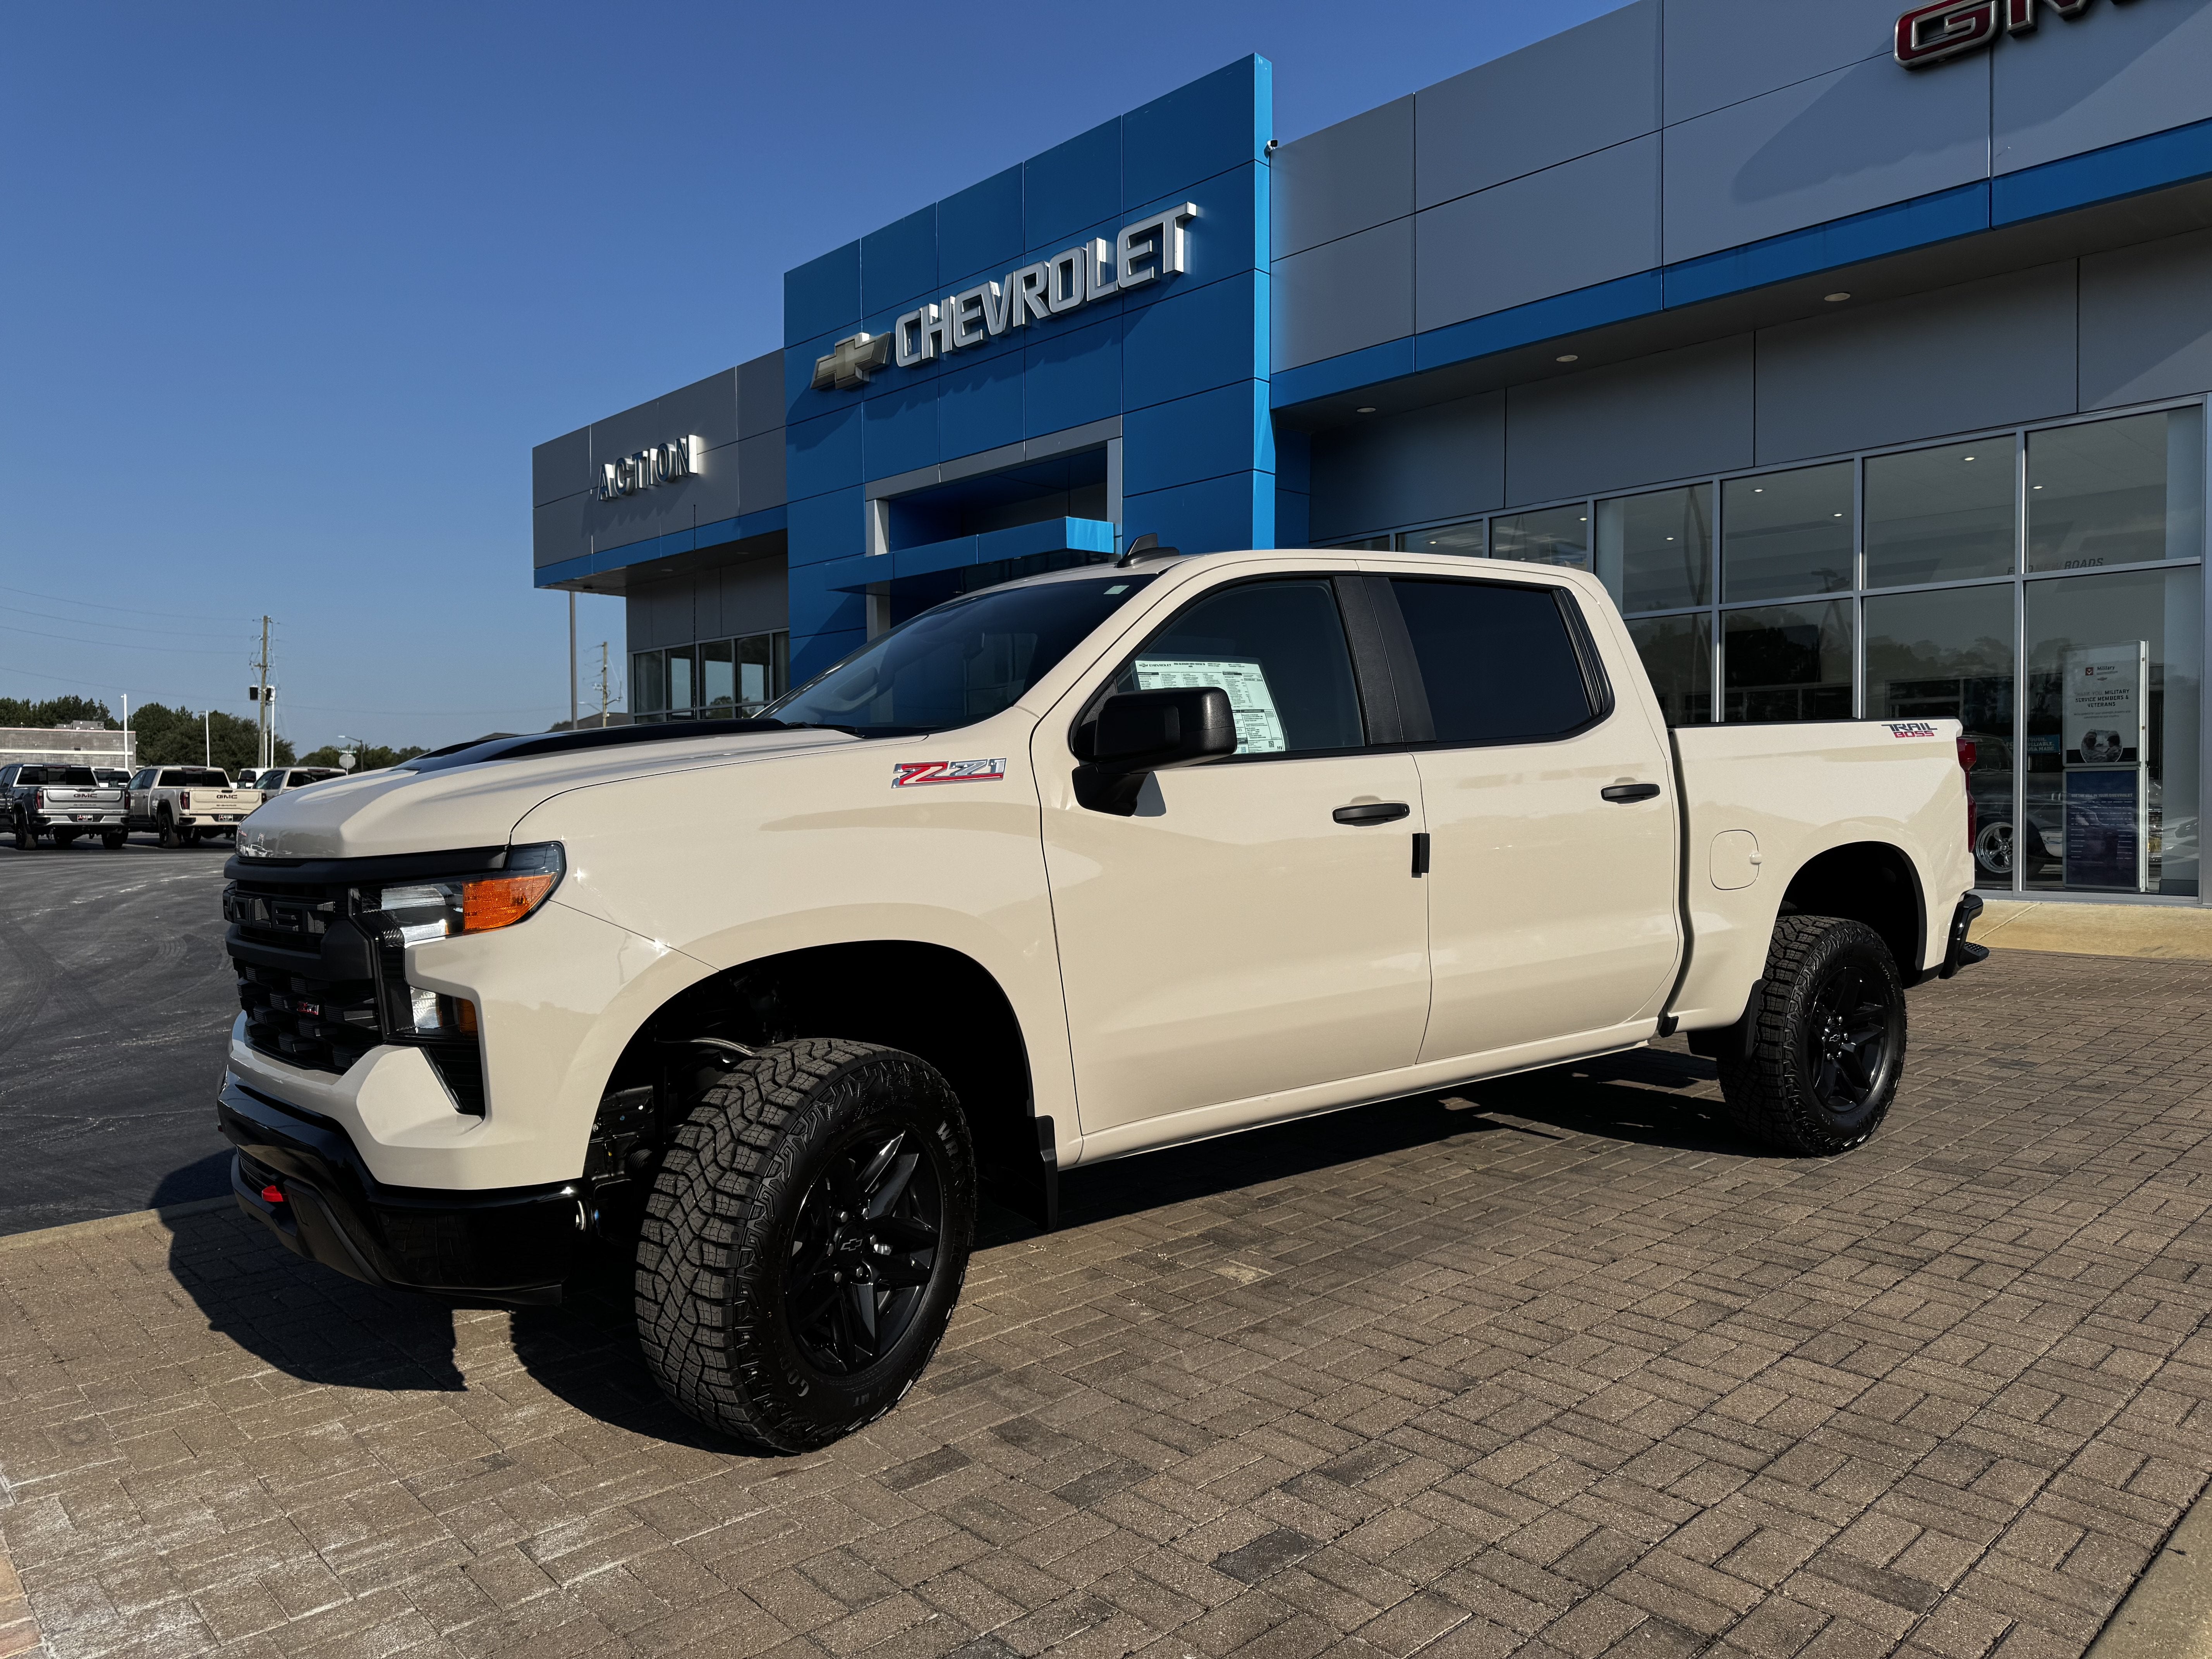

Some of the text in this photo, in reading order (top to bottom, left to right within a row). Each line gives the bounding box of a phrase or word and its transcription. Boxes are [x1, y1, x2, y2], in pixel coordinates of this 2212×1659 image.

[895, 201, 1197, 368] CHEVROLET
[597, 434, 698, 501] ACTION
[2064, 557, 2104, 570] ROADS
[1881, 723, 1937, 732] TRAIL
[891, 757, 1007, 788] Z71
